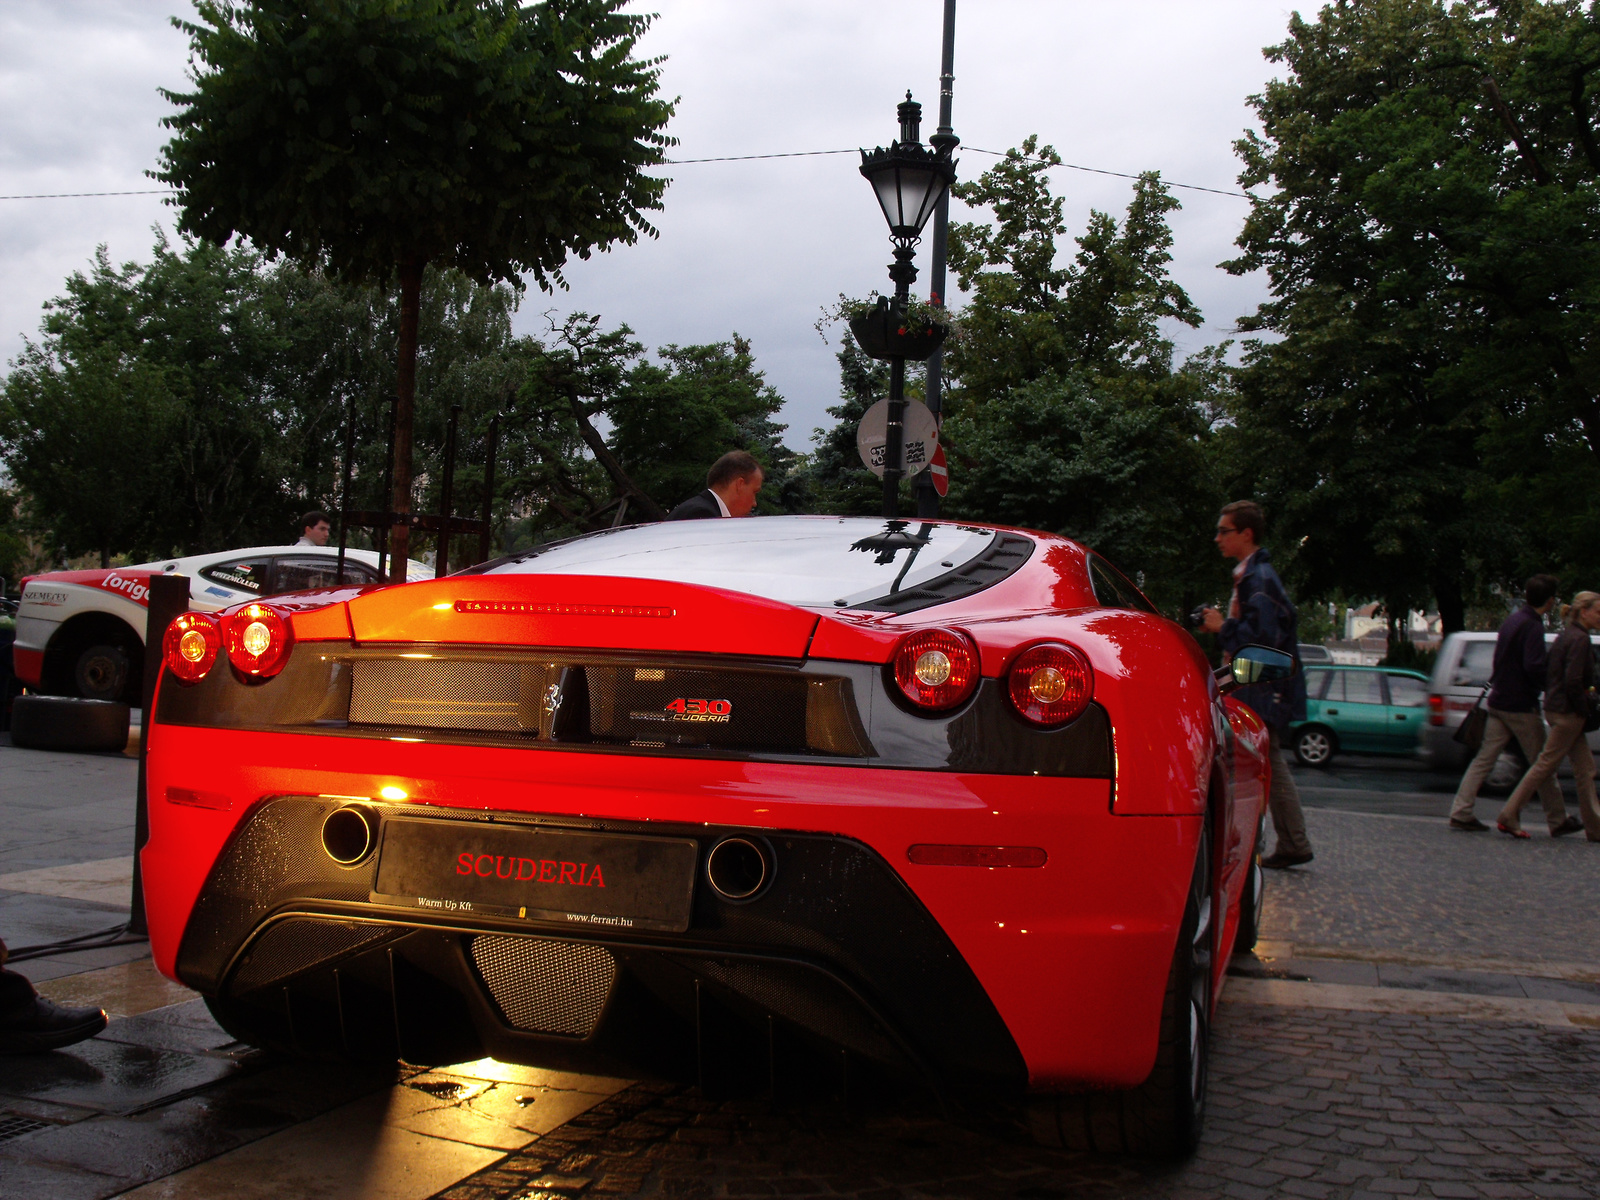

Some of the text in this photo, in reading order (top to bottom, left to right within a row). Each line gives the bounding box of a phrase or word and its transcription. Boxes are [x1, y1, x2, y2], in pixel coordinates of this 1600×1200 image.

[664, 698, 732, 716] 430
[456, 852, 606, 888] SCUDERIA
[417, 897, 474, 911] Warm Up Kft.
[566, 912, 634, 927] www.ferrari.hu
